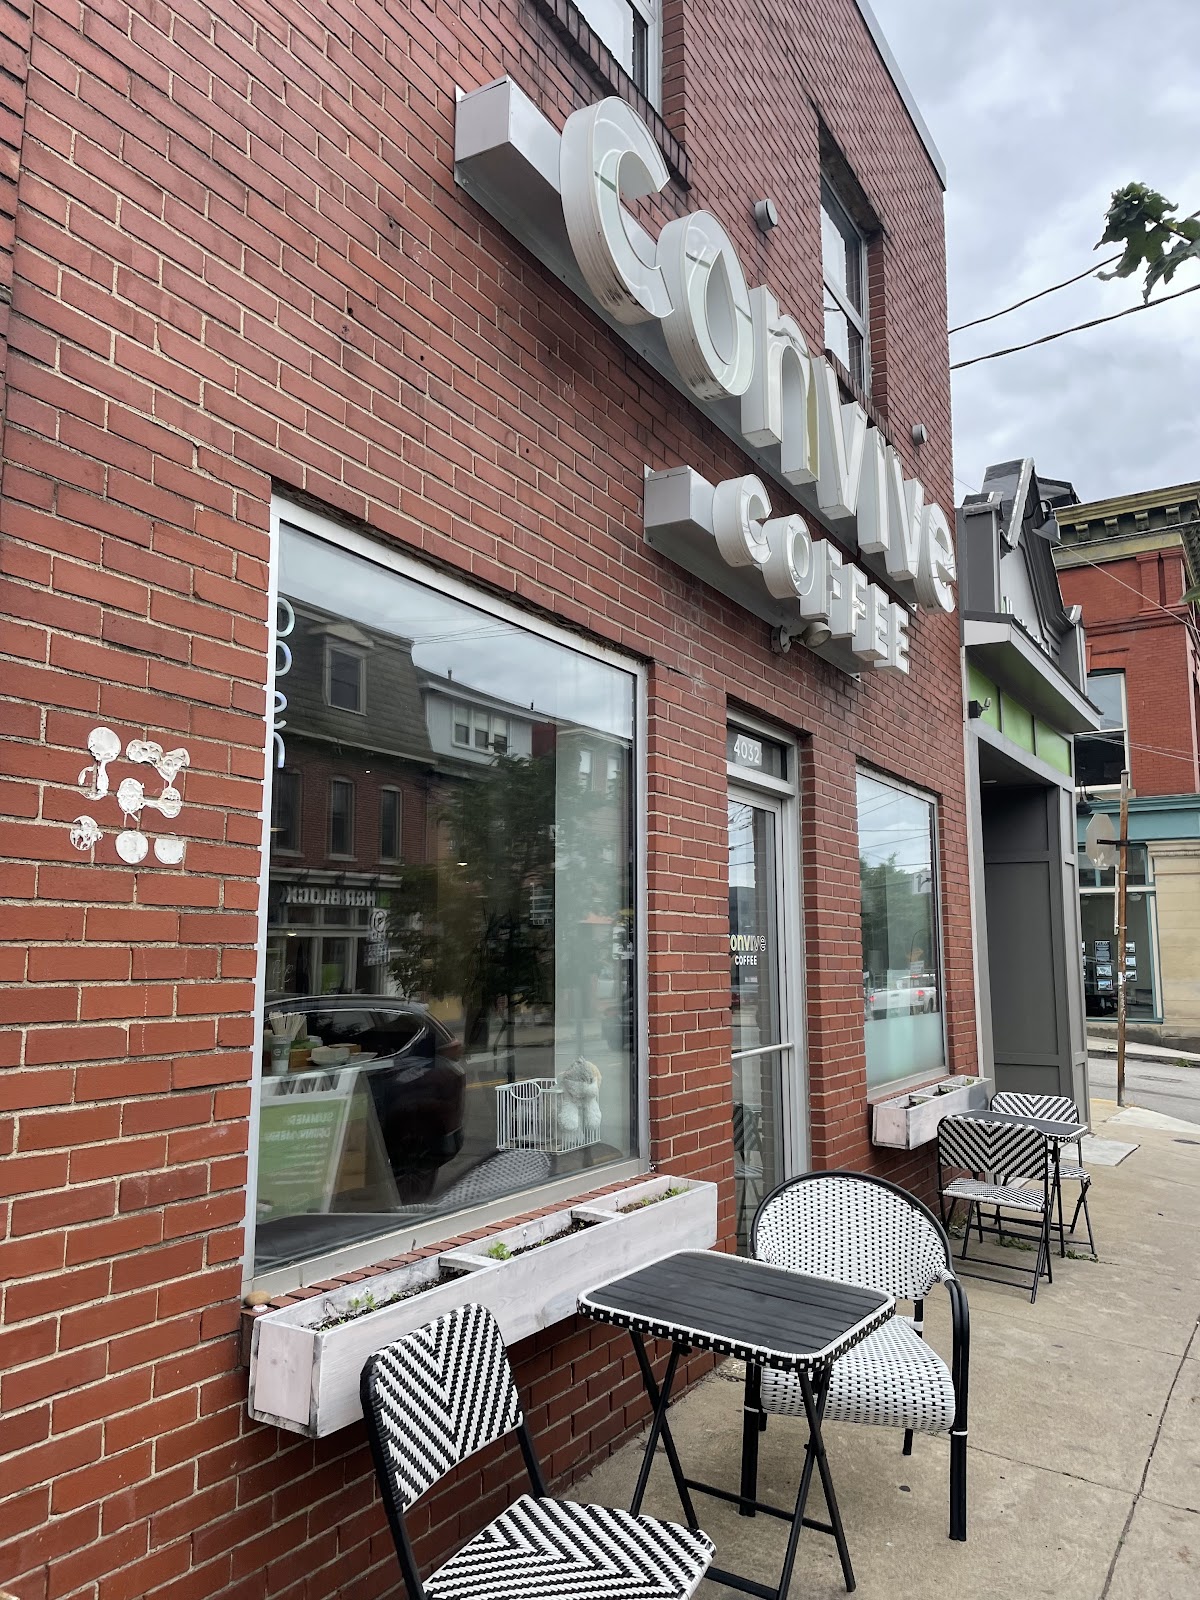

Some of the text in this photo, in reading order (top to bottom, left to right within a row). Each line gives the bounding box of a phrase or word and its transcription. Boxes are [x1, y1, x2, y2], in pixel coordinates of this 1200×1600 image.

[712, 474, 909, 674] COFFEE
[733, 739, 760, 764] 4032
[734, 955, 758, 966] COFFEE
